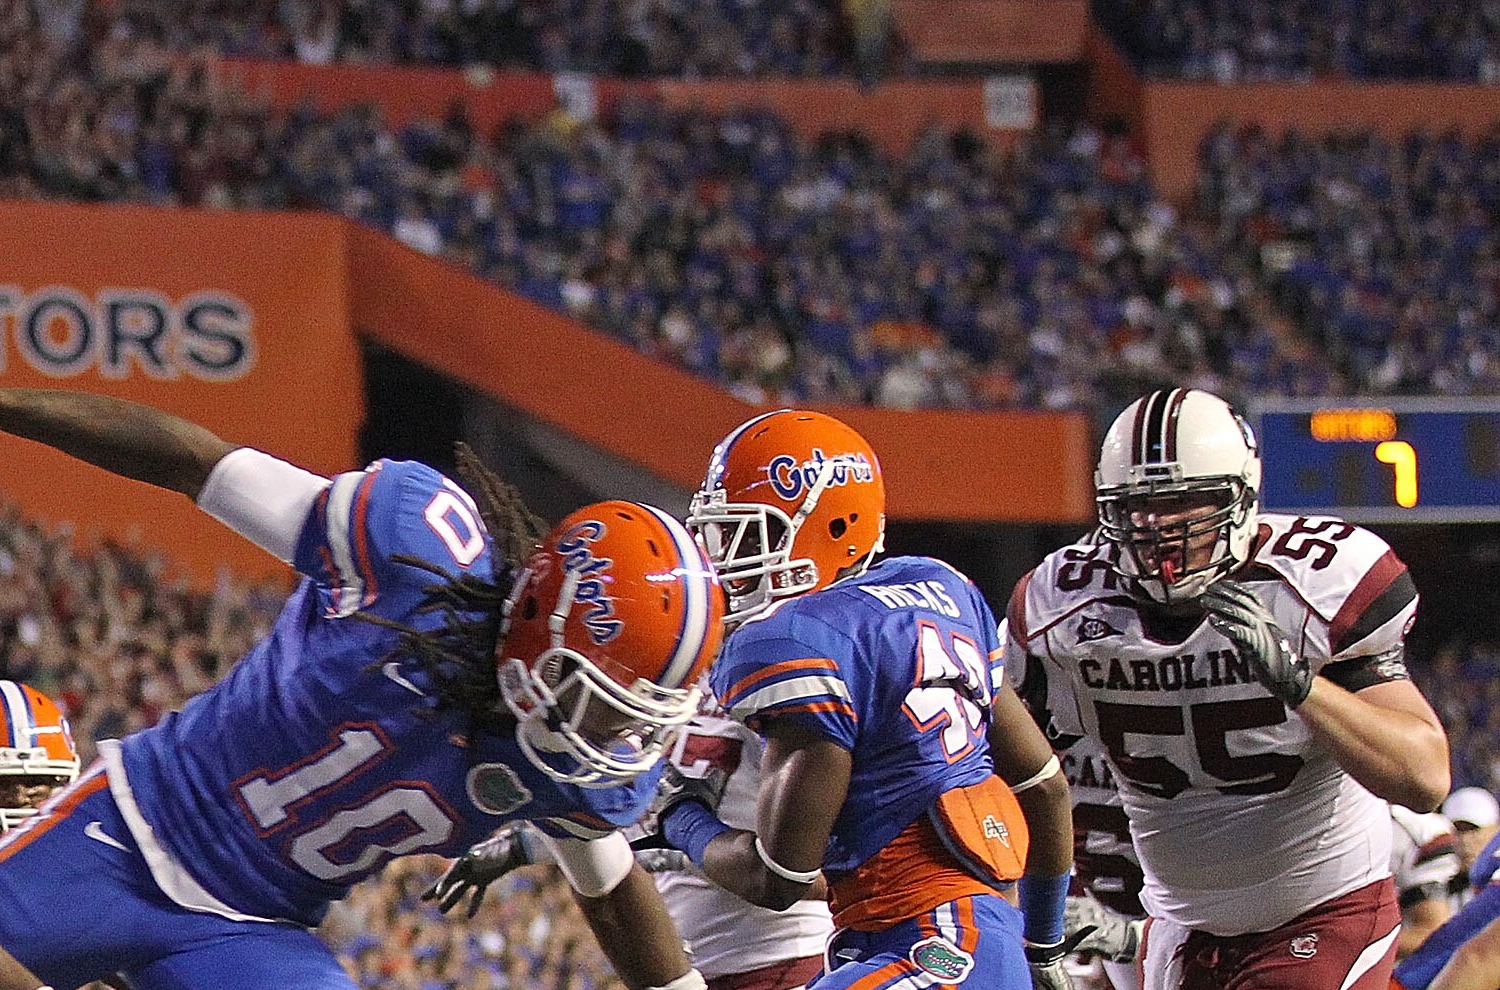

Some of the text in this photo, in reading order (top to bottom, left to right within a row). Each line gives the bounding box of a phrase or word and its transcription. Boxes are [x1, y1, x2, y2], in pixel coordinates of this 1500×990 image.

[767, 448, 874, 501] Gators
[556, 520, 625, 645] Gators
[858, 580, 961, 618] HICKS
[1078, 648, 1257, 691] CAROLIN
[1096, 697, 1305, 799] 55
[234, 720, 462, 882] 10
